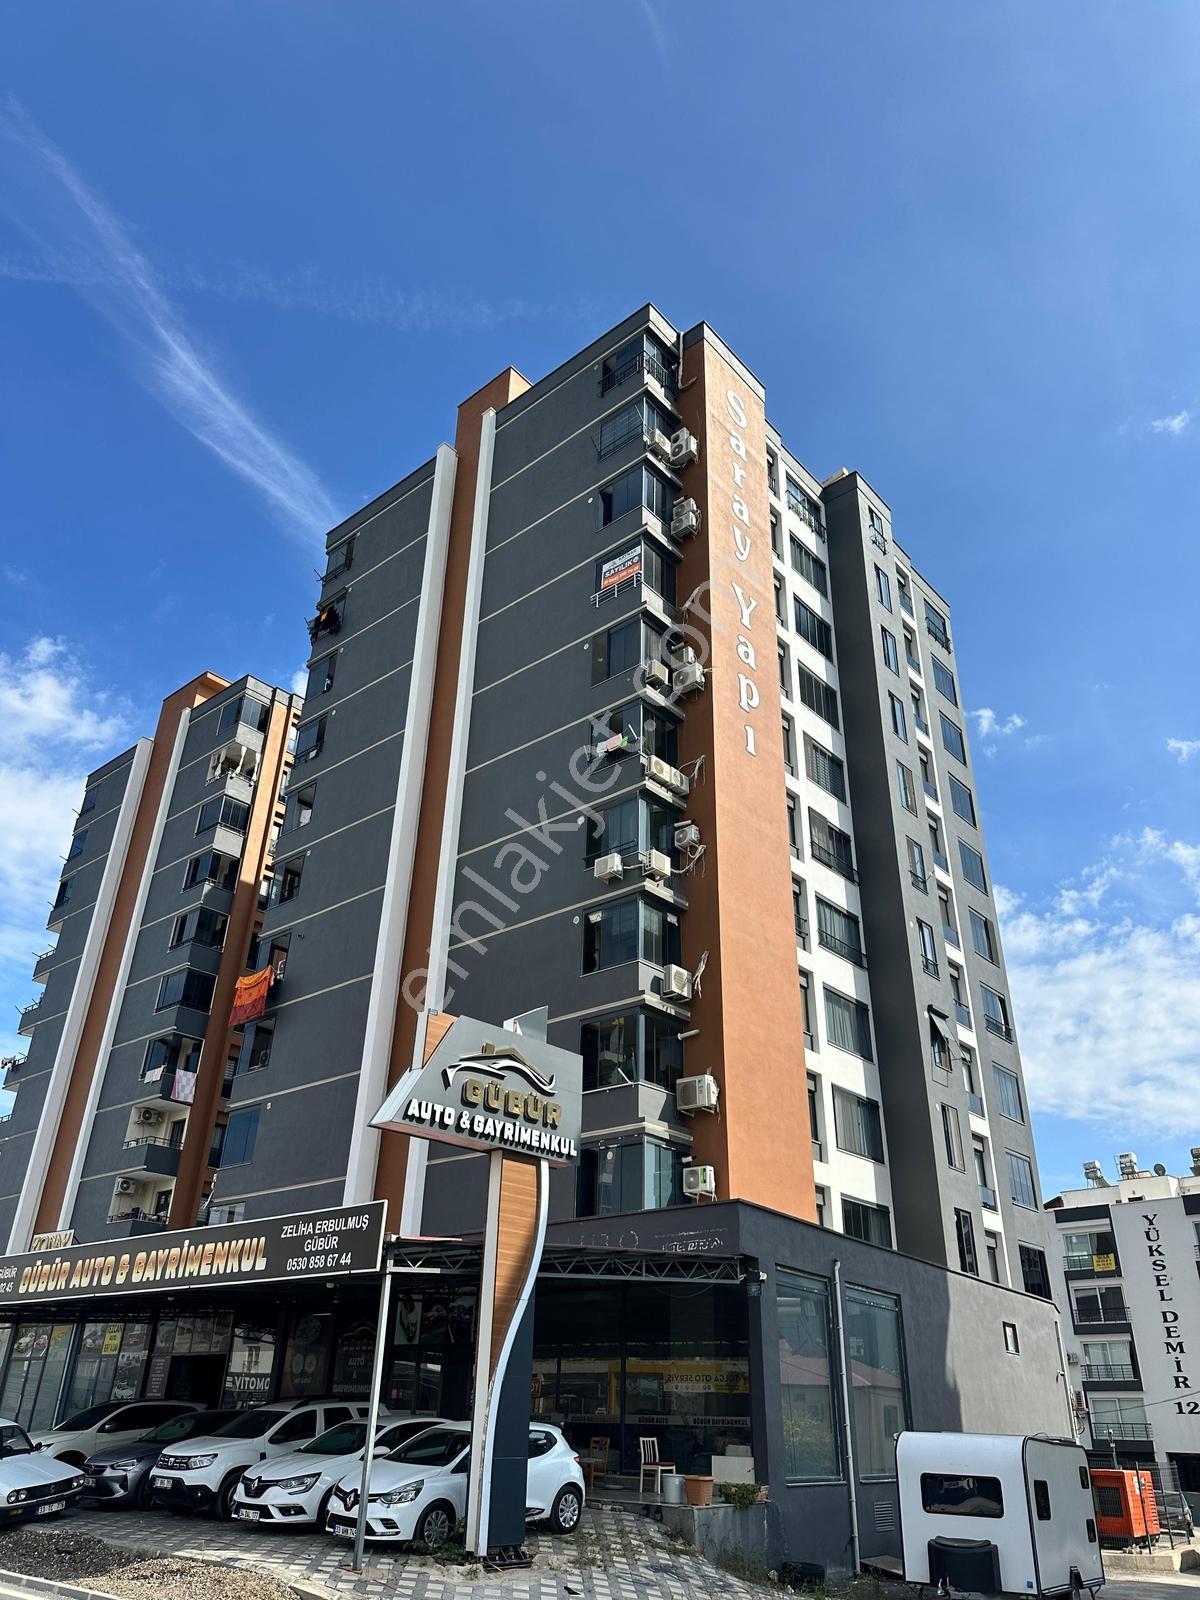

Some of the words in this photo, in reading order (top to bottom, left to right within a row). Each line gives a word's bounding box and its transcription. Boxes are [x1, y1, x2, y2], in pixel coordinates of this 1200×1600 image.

[726, 388, 752, 561] Saray
[732, 582, 760, 757] Yapı
[407, 1098, 455, 1125] AUTO
[460, 1111, 470, 1129] &
[474, 1115, 577, 1156] GAYRİMENKUL
[462, 1078, 562, 1127] GÜBÜR
[281, 1221, 313, 1238] ZELİHA
[315, 1215, 369, 1233] ERBULMUŞ
[304, 1234, 338, 1252] GÜBÜR
[19, 1257, 71, 1293] GÜBÜR
[69, 1256, 115, 1288] AUTO
[116, 1253, 130, 1284] &
[132, 1237, 267, 1282] GAYRİMENKUL
[287, 1257, 307, 1271] 0530
[309, 1255, 324, 1269] 858
[327, 1253, 338, 1267] 67
[340, 1252, 352, 1266] 44
[1141, 1213, 1173, 1302] YÜKSEL
[1161, 1310, 1191, 1389] DEMİR
